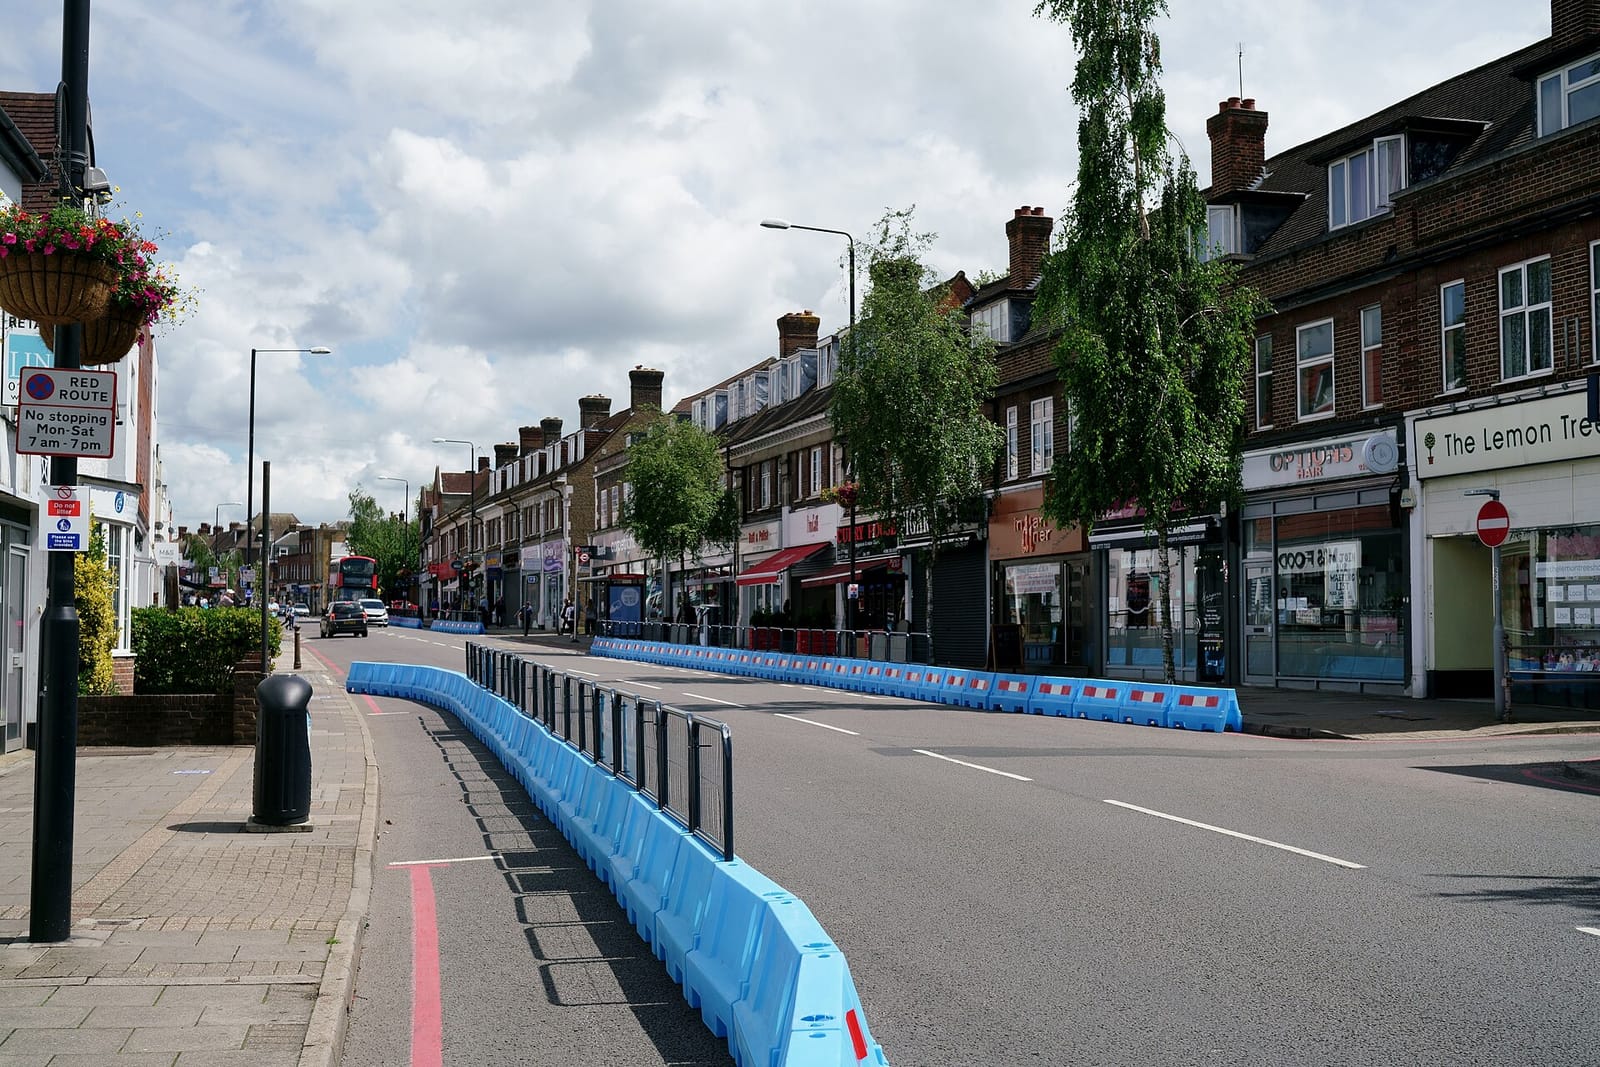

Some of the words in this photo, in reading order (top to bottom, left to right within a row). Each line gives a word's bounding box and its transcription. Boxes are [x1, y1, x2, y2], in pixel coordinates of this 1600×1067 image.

[70, 376, 100, 389] RED
[59, 389, 109, 402] ROUTE
[25, 409, 45, 420] No
[48, 411, 107, 426] stopping
[36, 423, 95, 437] Mon-Sat
[1444, 432, 1476, 457] The
[1483, 422, 1552, 452] Lemon
[1269, 443, 1353, 472] OPTIONS
[1296, 465, 1323, 479] HAIR
[837, 525, 865, 544] CURRY
